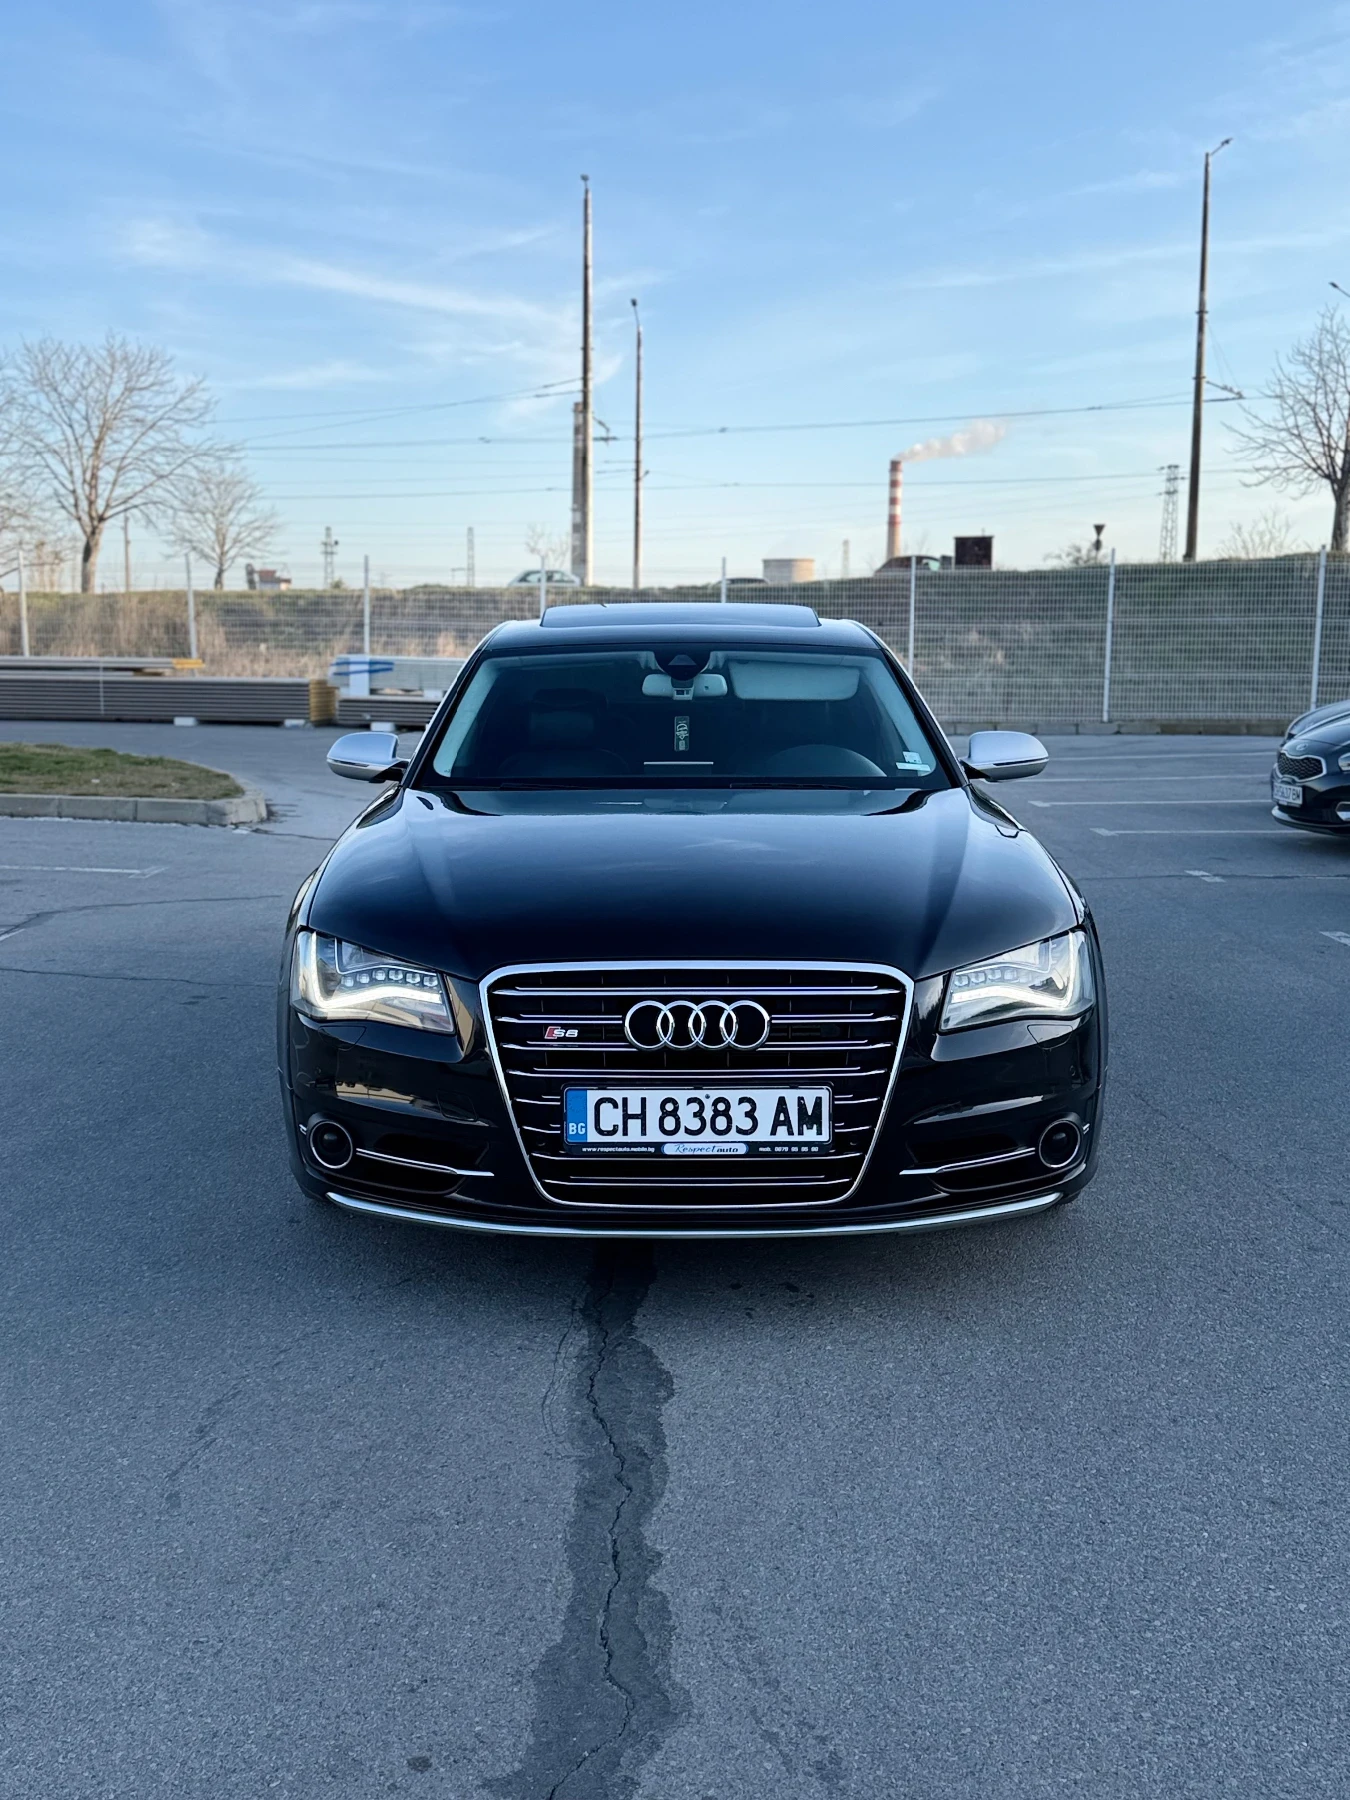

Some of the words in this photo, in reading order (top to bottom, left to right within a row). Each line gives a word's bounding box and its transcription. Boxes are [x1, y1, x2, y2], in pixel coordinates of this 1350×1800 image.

[552, 1029, 579, 1038] S8
[594, 1097, 647, 1137] CH
[658, 1096, 759, 1137] 8383
[770, 1095, 823, 1136] AM
[568, 1122, 586, 1135] BG
